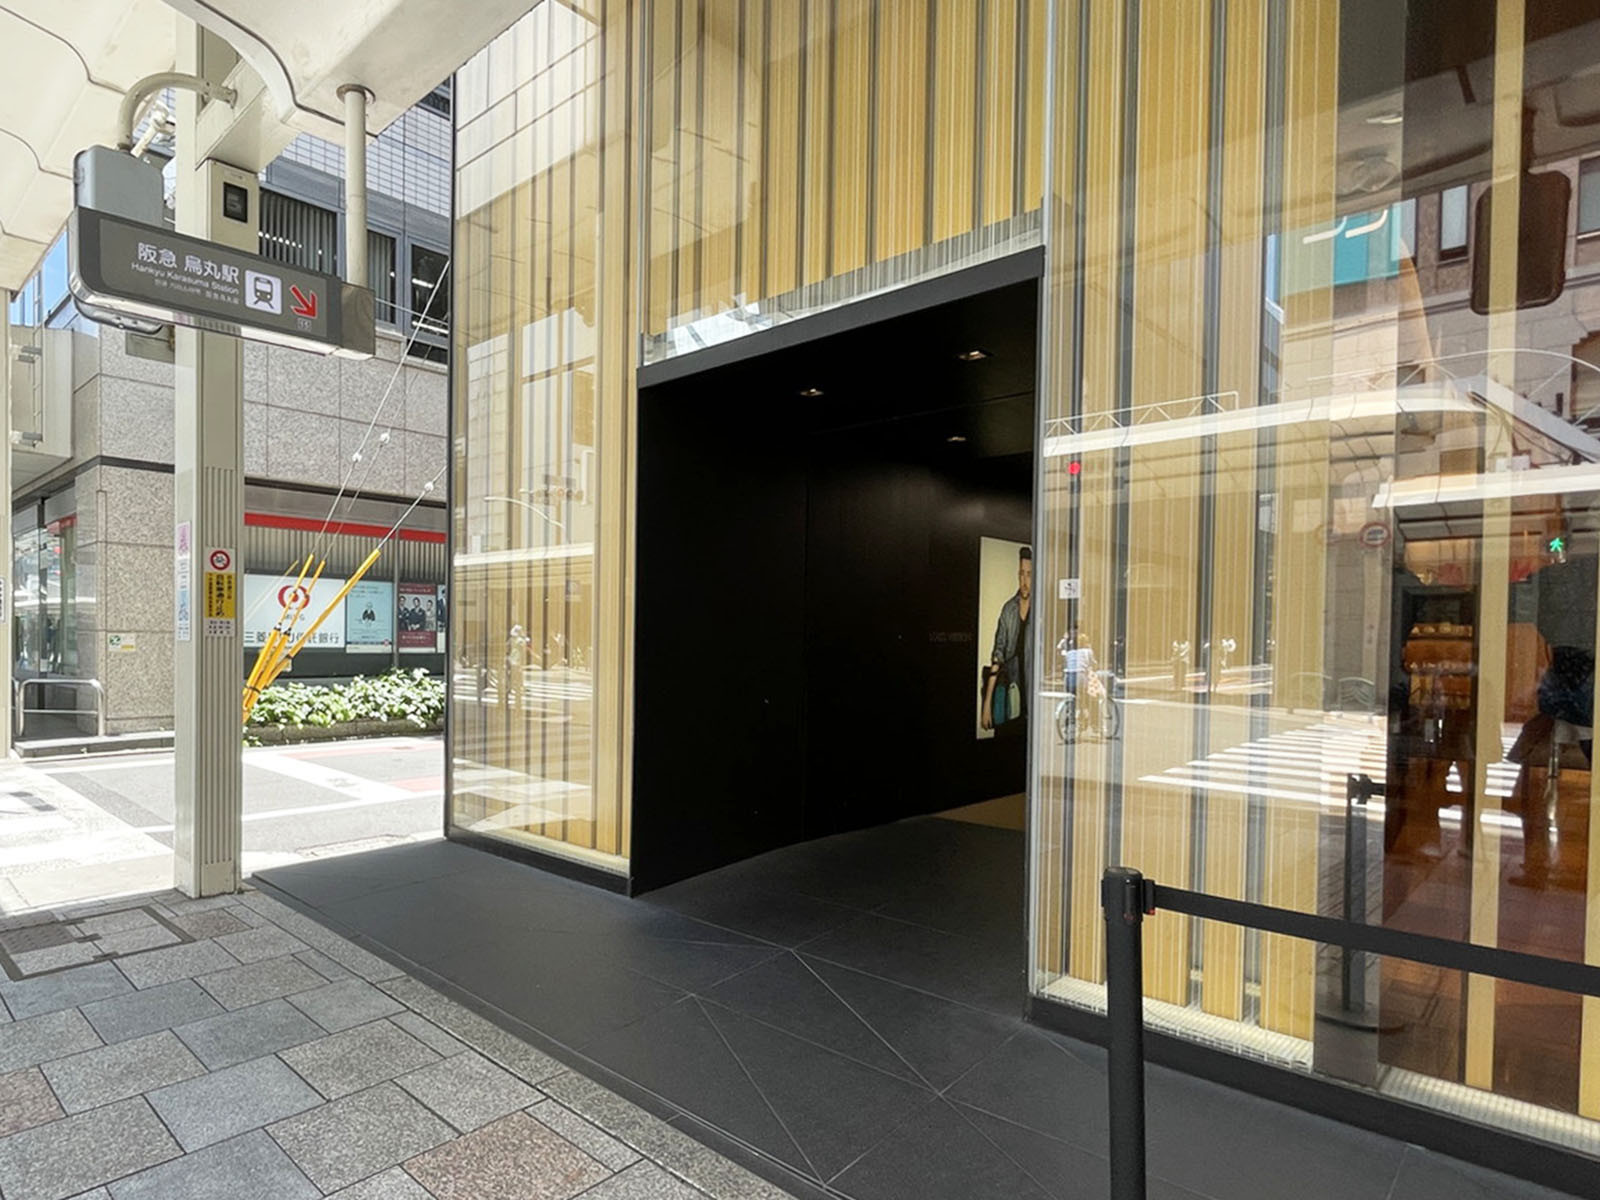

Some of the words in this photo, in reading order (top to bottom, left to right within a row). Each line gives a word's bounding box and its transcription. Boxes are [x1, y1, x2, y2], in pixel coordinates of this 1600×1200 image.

[131, 262, 166, 277] Hankyu
[167, 271, 209, 288] Karasuma
[211, 281, 240, 295] Station
[138, 242, 177, 269] 阪急
[184, 255, 240, 284] 烏丸駅
